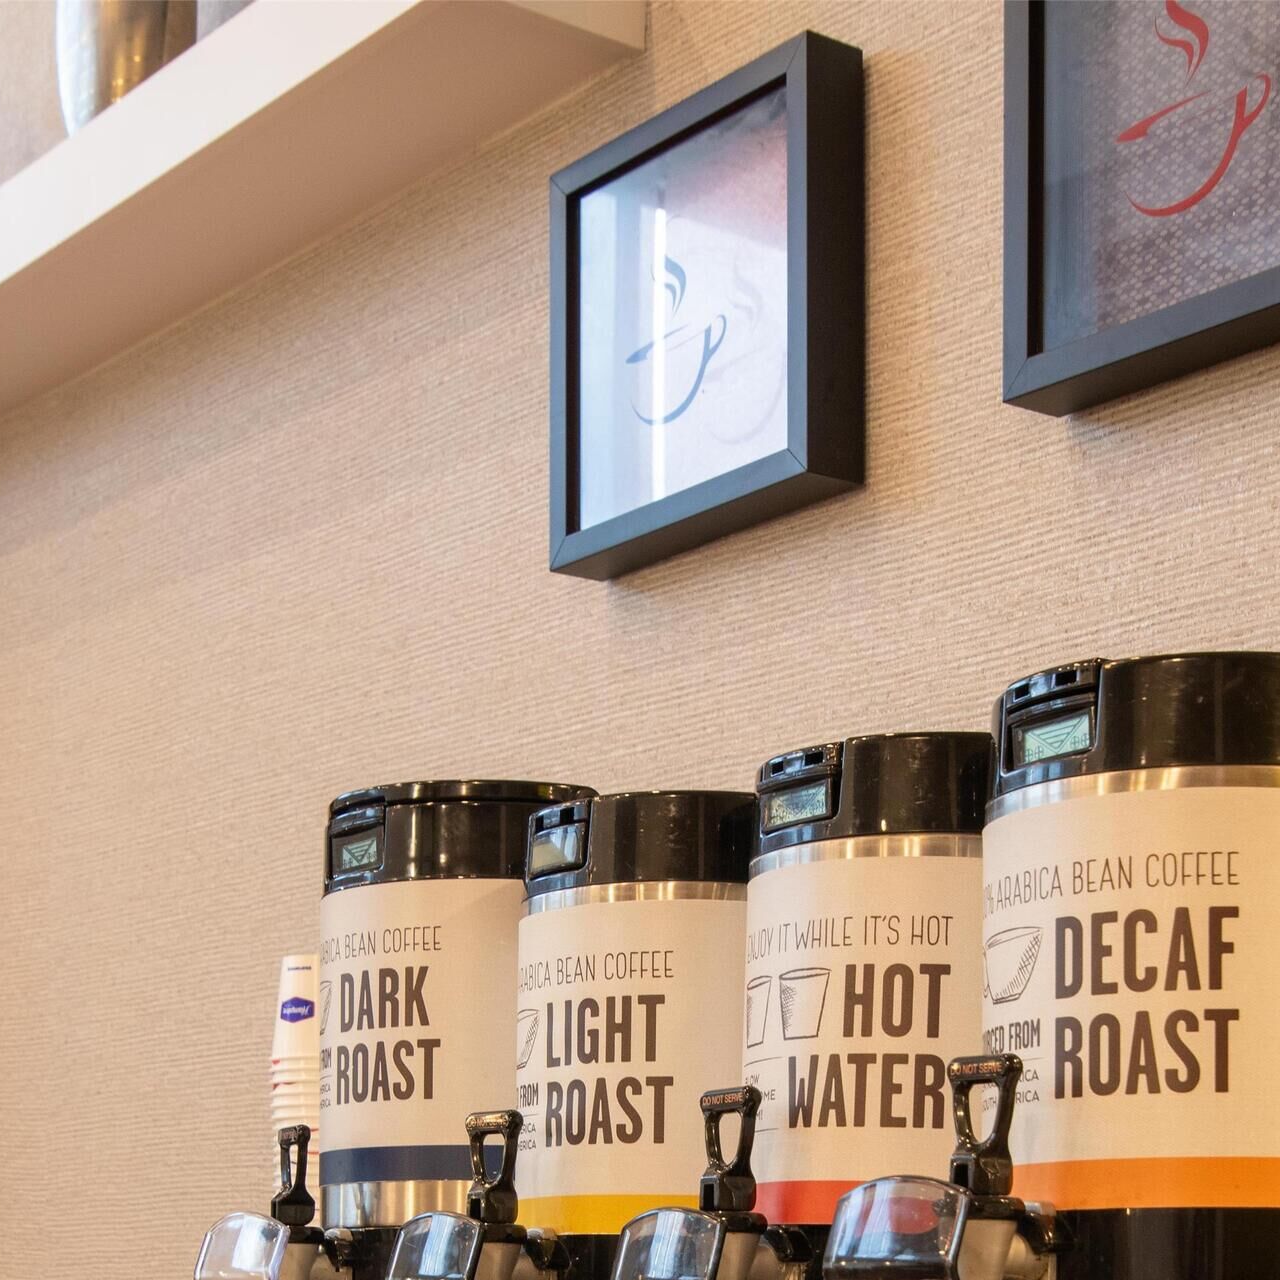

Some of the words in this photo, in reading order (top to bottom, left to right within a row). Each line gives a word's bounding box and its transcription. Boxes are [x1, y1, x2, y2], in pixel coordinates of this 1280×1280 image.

[996, 864, 1063, 912] ARABICA
[1072, 855, 1133, 895] BEAN
[1145, 851, 1240, 888] COFFEE
[344, 930, 376, 960] BEAN
[382, 925, 442, 955] COFFEE
[778, 922, 791, 953] IT
[794, 916, 854, 951] WHILE
[863, 914, 901, 946] IT'S
[910, 914, 954, 946] HOT
[1055, 905, 1240, 1000] DECAF
[340, 965, 430, 1033] DARK
[556, 954, 596, 986] BEAN
[604, 950, 675, 981] COFFEE
[842, 962, 952, 1038] HOT
[546, 994, 666, 1069] LIGHT
[1009, 1017, 1041, 1052] FROM
[1054, 1008, 1240, 1100] ROAST
[336, 1038, 441, 1106] ROAST
[519, 1082, 539, 1109] FROM
[702, 1096, 711, 1105] DO
[712, 1095, 724, 1105] NOT
[787, 1052, 946, 1129] WATER
[545, 1075, 674, 1148] ROAST
